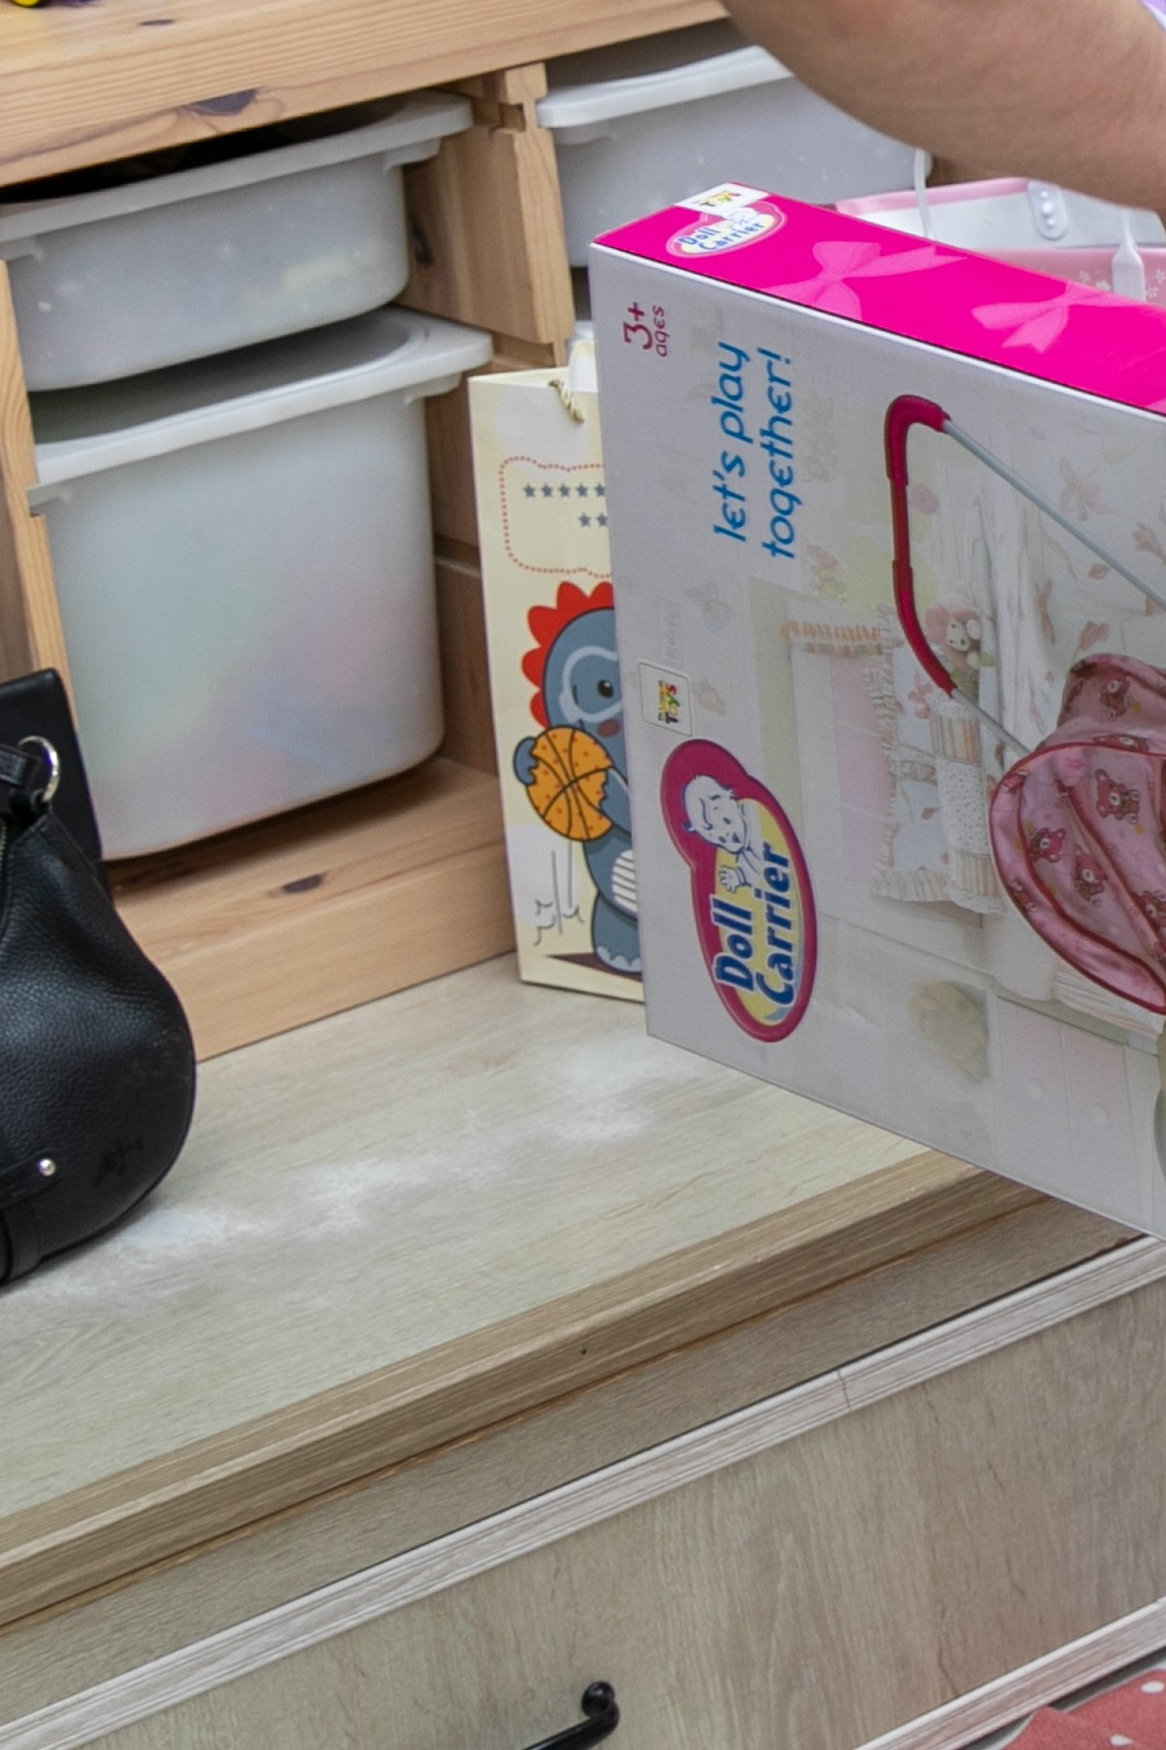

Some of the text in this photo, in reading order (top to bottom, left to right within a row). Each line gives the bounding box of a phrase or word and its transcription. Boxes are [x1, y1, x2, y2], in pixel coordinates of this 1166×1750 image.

[677, 226, 721, 246] Doll
[700, 222, 765, 251] Carrier
[622, 301, 654, 351] 3+
[652, 304, 671, 357] ages
[710, 341, 754, 543] let's play
[757, 346, 803, 560] together!
[712, 895, 753, 991] Doll
[754, 841, 796, 1006] Carrier
